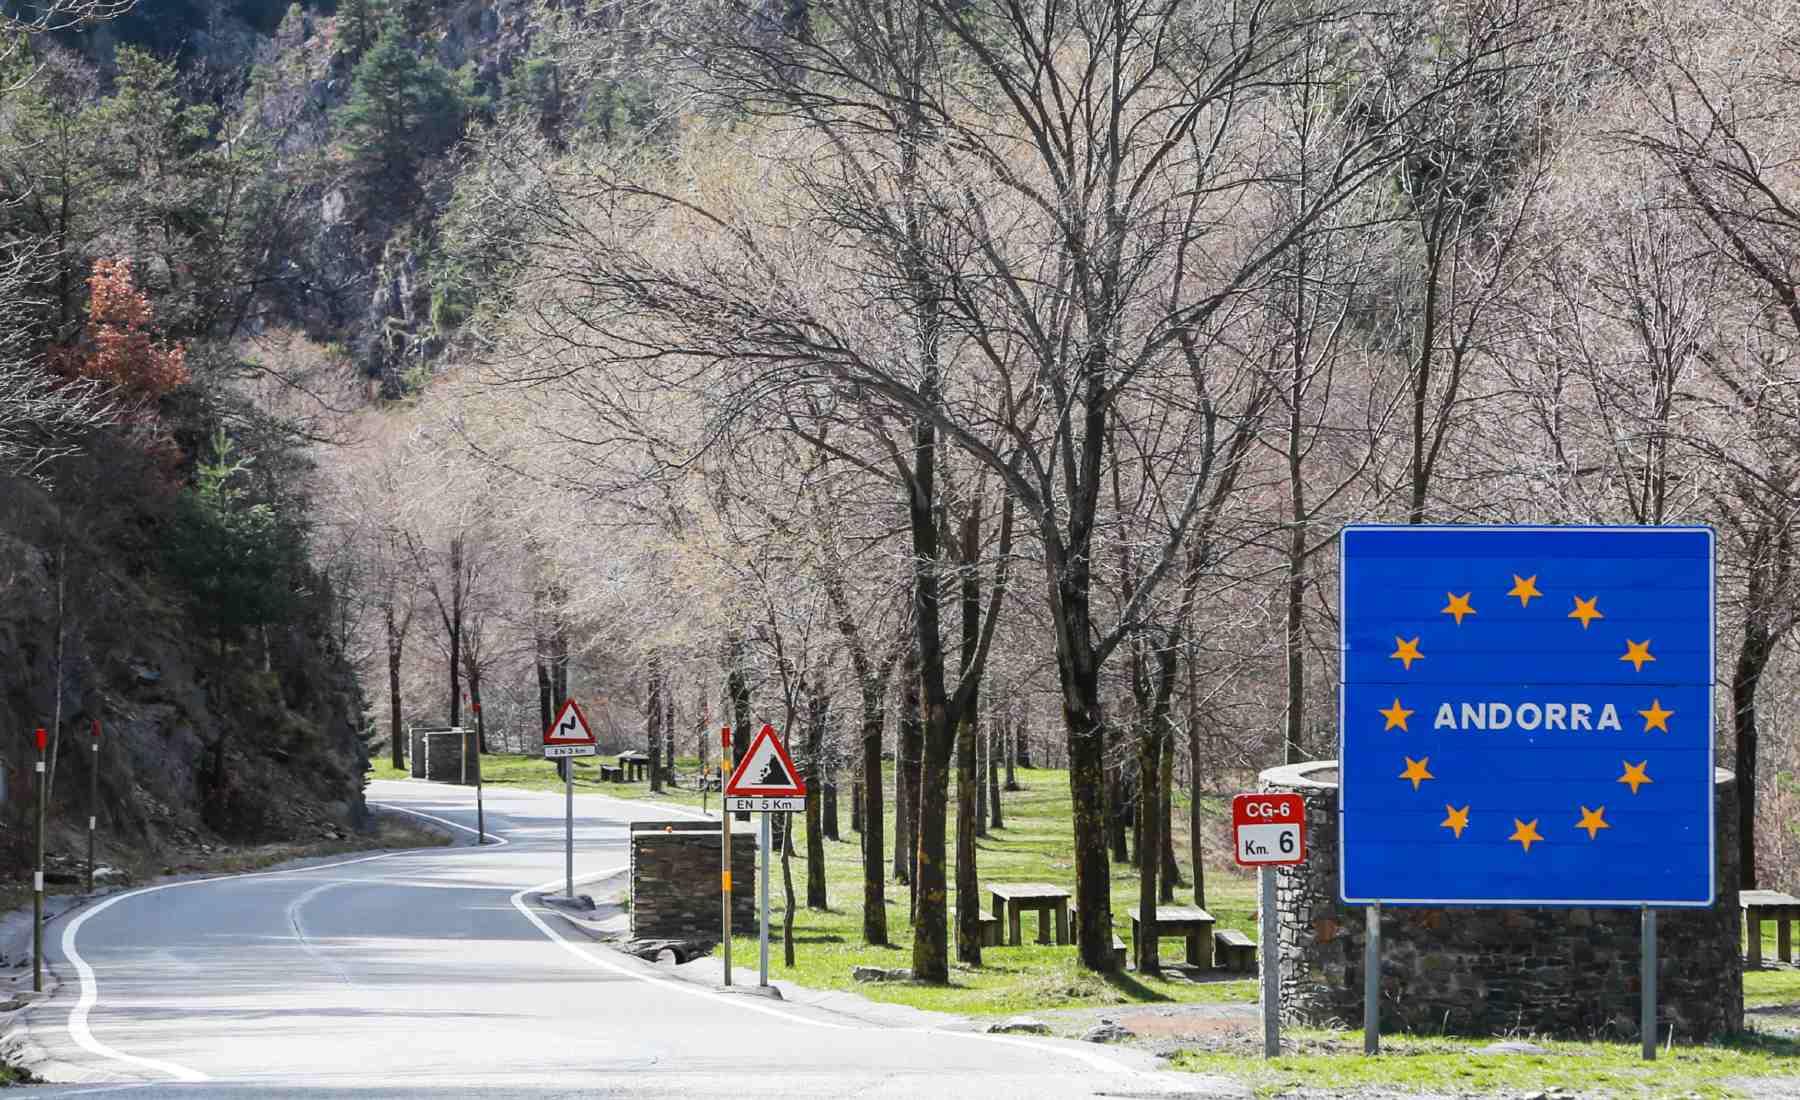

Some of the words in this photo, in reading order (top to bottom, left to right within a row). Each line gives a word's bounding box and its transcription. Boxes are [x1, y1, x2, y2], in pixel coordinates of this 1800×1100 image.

[1433, 702, 1622, 731] ANDORRA
[737, 799, 753, 810] EN
[762, 799, 769, 810] 5
[773, 799, 792, 810] Km
[1246, 801, 1290, 817] CG-6
[1279, 830, 1294, 853] 6
